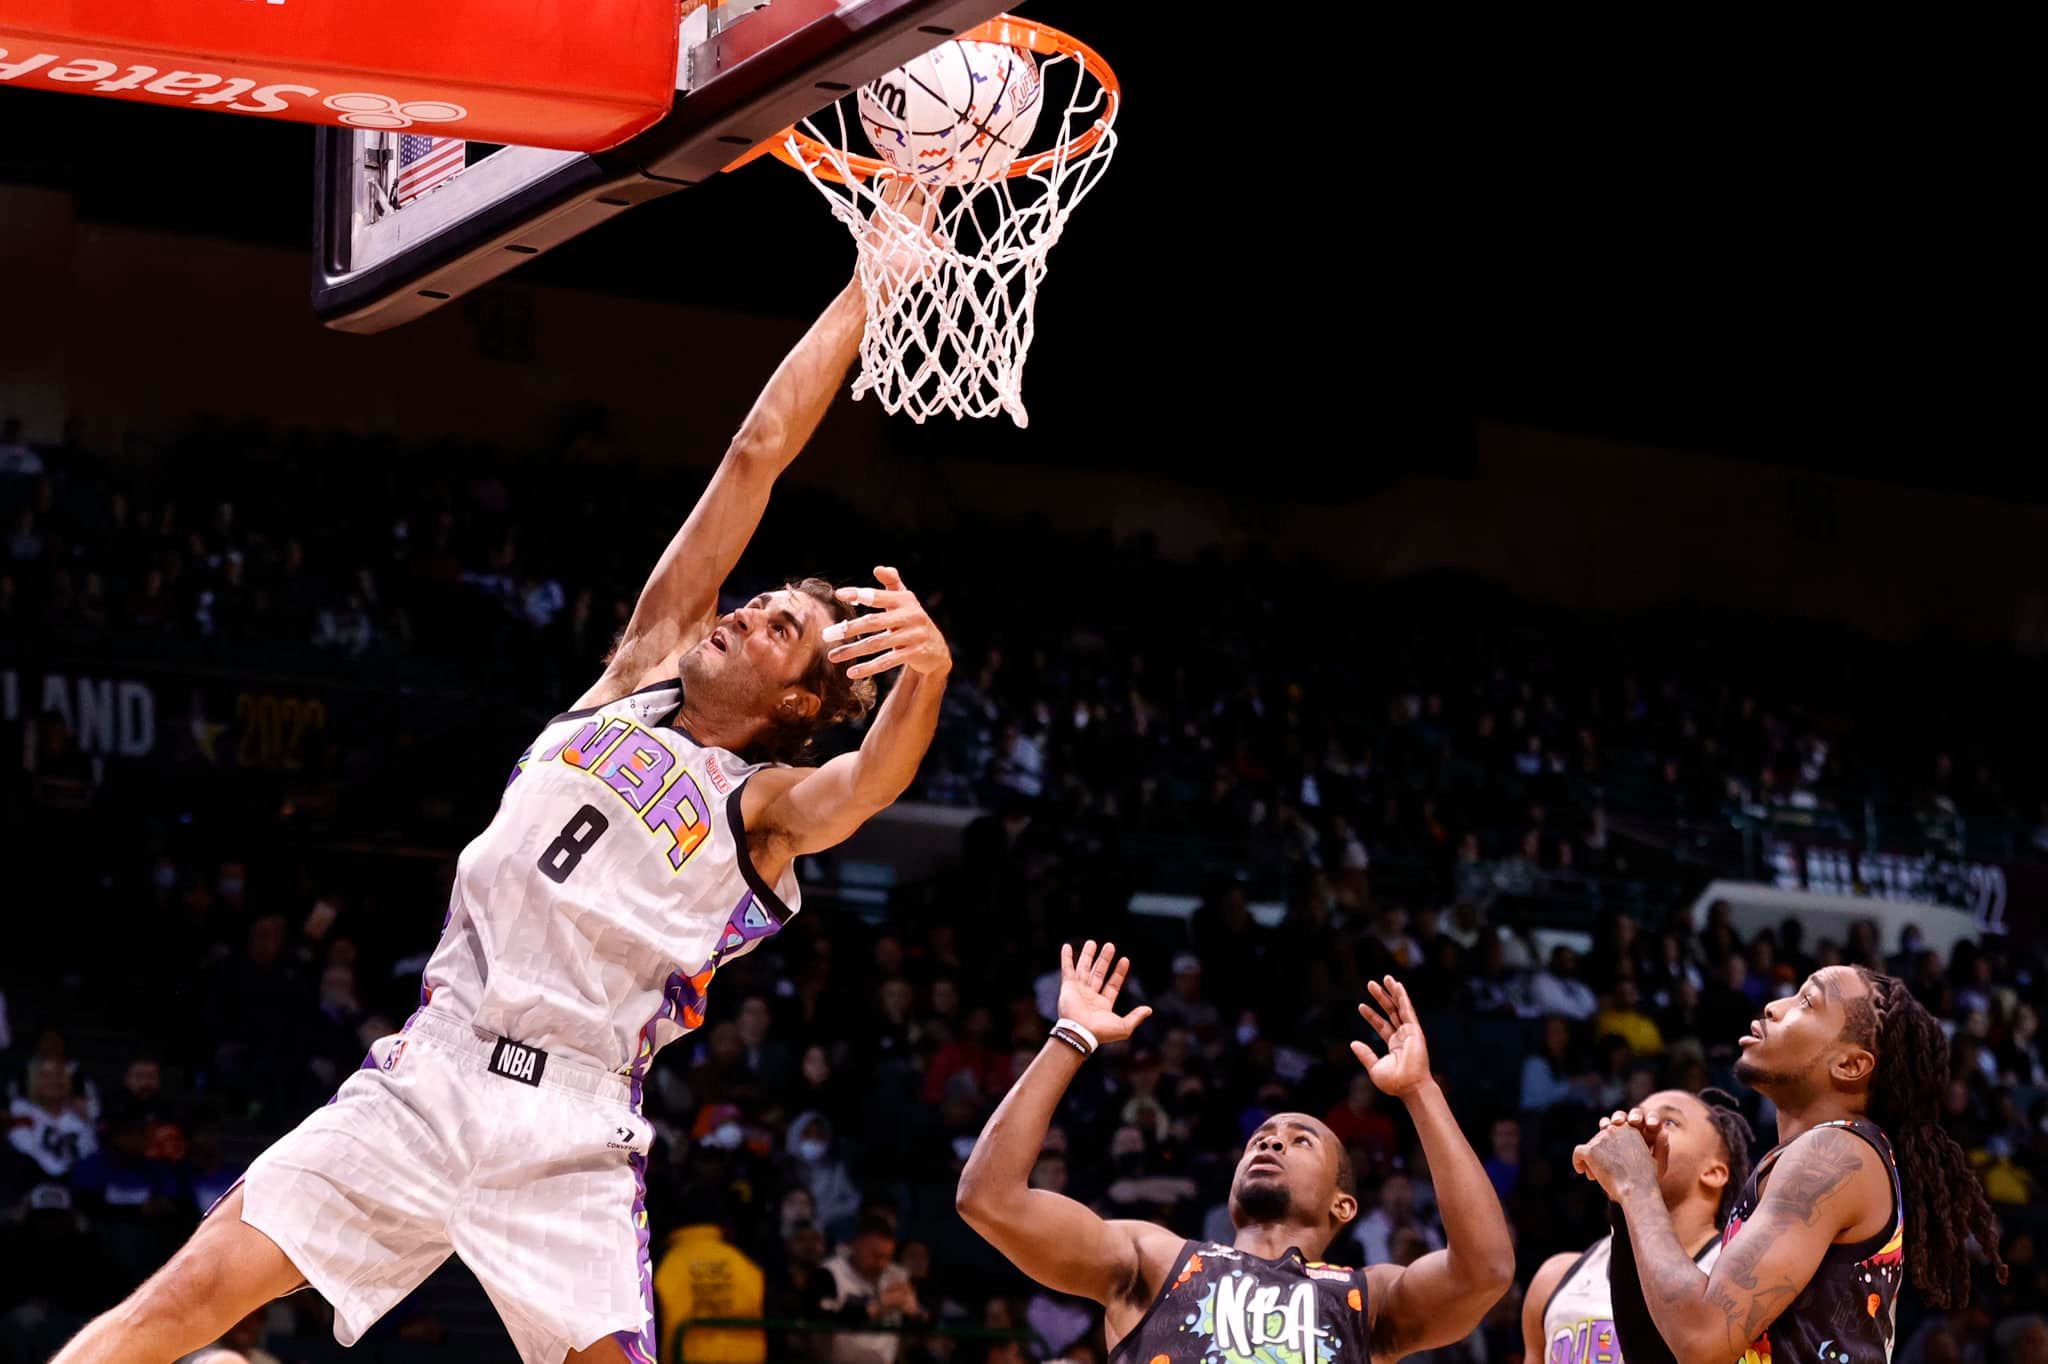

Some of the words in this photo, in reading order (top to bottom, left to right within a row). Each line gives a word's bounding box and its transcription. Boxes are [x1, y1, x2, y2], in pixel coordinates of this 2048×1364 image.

[537, 804, 609, 884] 8
[497, 1043, 537, 1081] NBA
[1216, 1275, 1329, 1364] NBA
